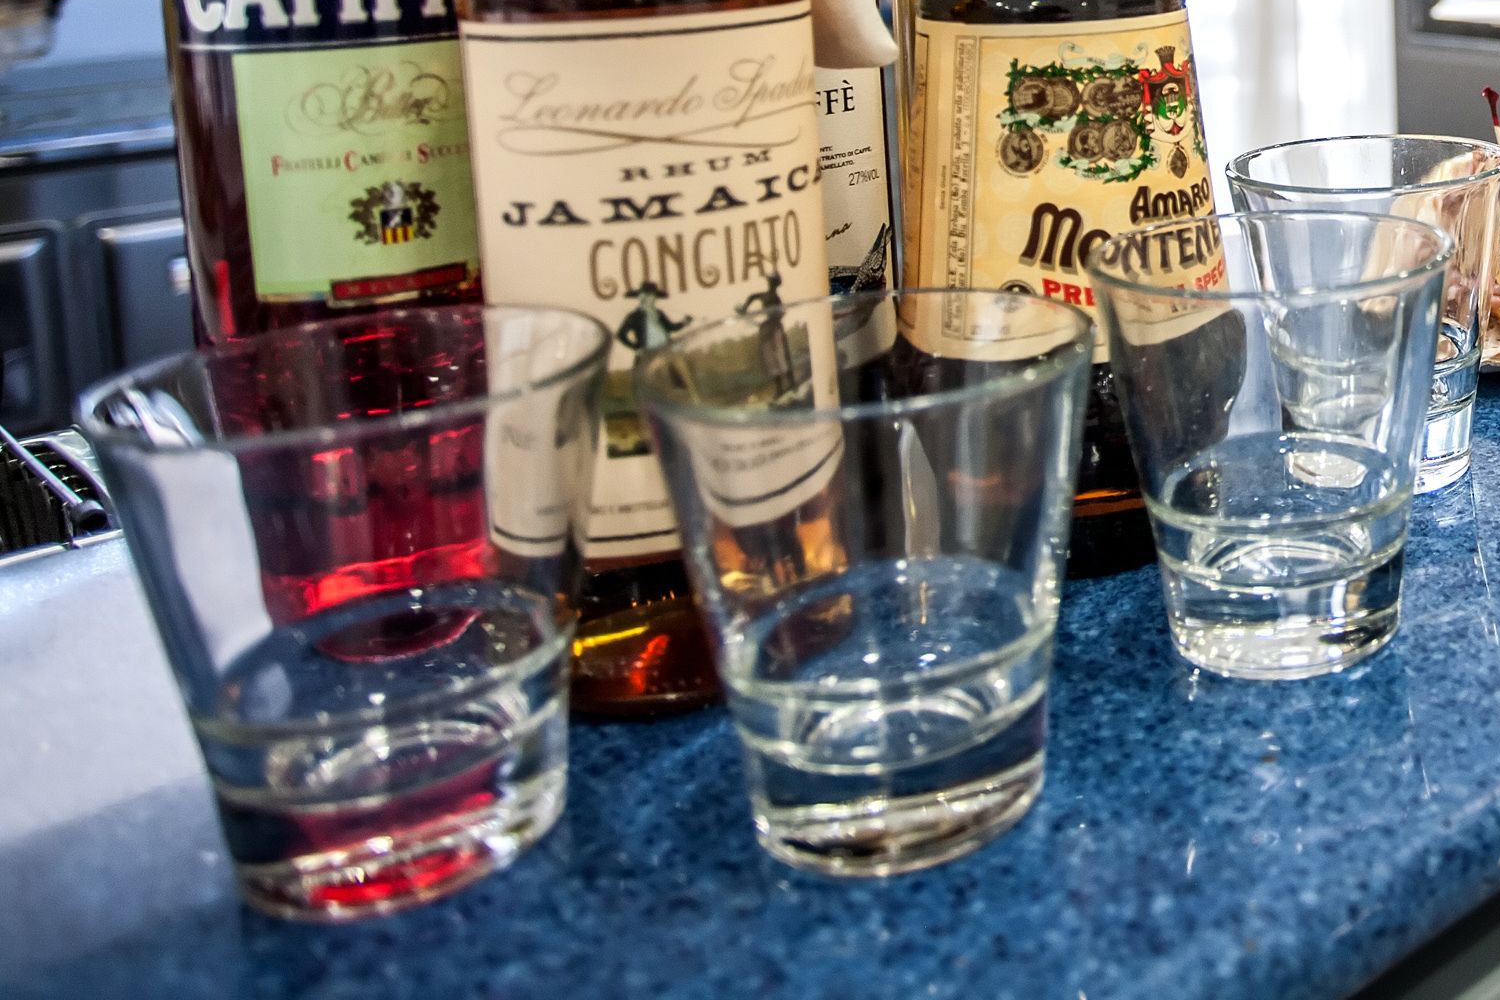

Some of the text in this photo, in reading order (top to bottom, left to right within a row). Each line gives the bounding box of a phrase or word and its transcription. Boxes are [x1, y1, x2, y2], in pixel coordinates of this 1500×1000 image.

[620, 149, 772, 183] RHUM
[1129, 176, 1210, 225] AMARO
[588, 208, 801, 301] CONCIATO
